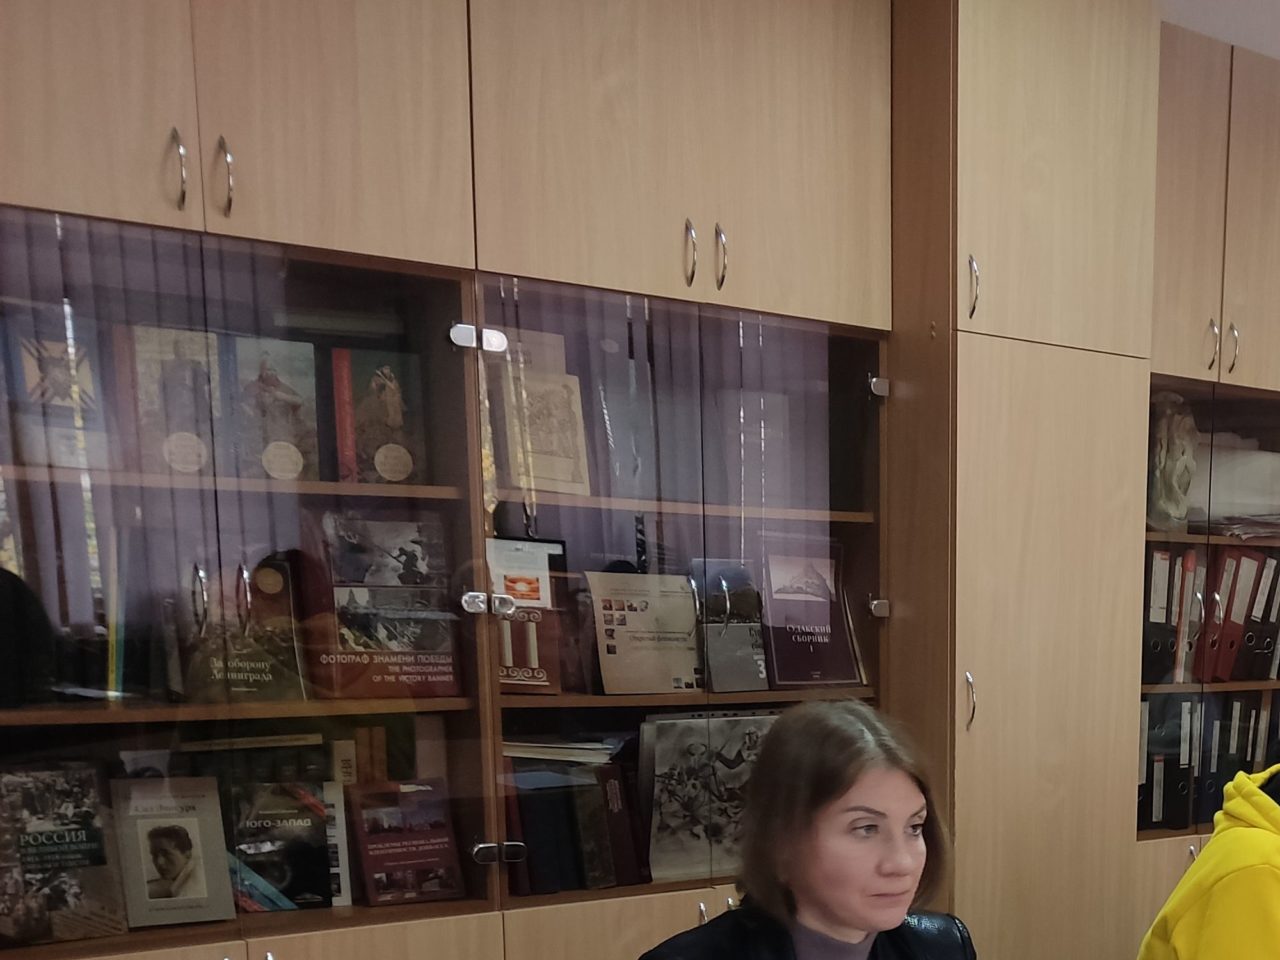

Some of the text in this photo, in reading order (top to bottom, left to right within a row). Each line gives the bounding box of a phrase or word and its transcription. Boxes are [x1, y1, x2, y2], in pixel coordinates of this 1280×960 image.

[792, 635, 829, 643] СБОРНИК
[320, 654, 453, 664] ФОТОГРАФ ЗНАМЕНИ ПОБЕДЫ
[227, 658, 271, 672] оборону
[246, 818, 312, 829] ЮГО-ЗАПАД
[19, 830, 87, 846] РОССИЯ
